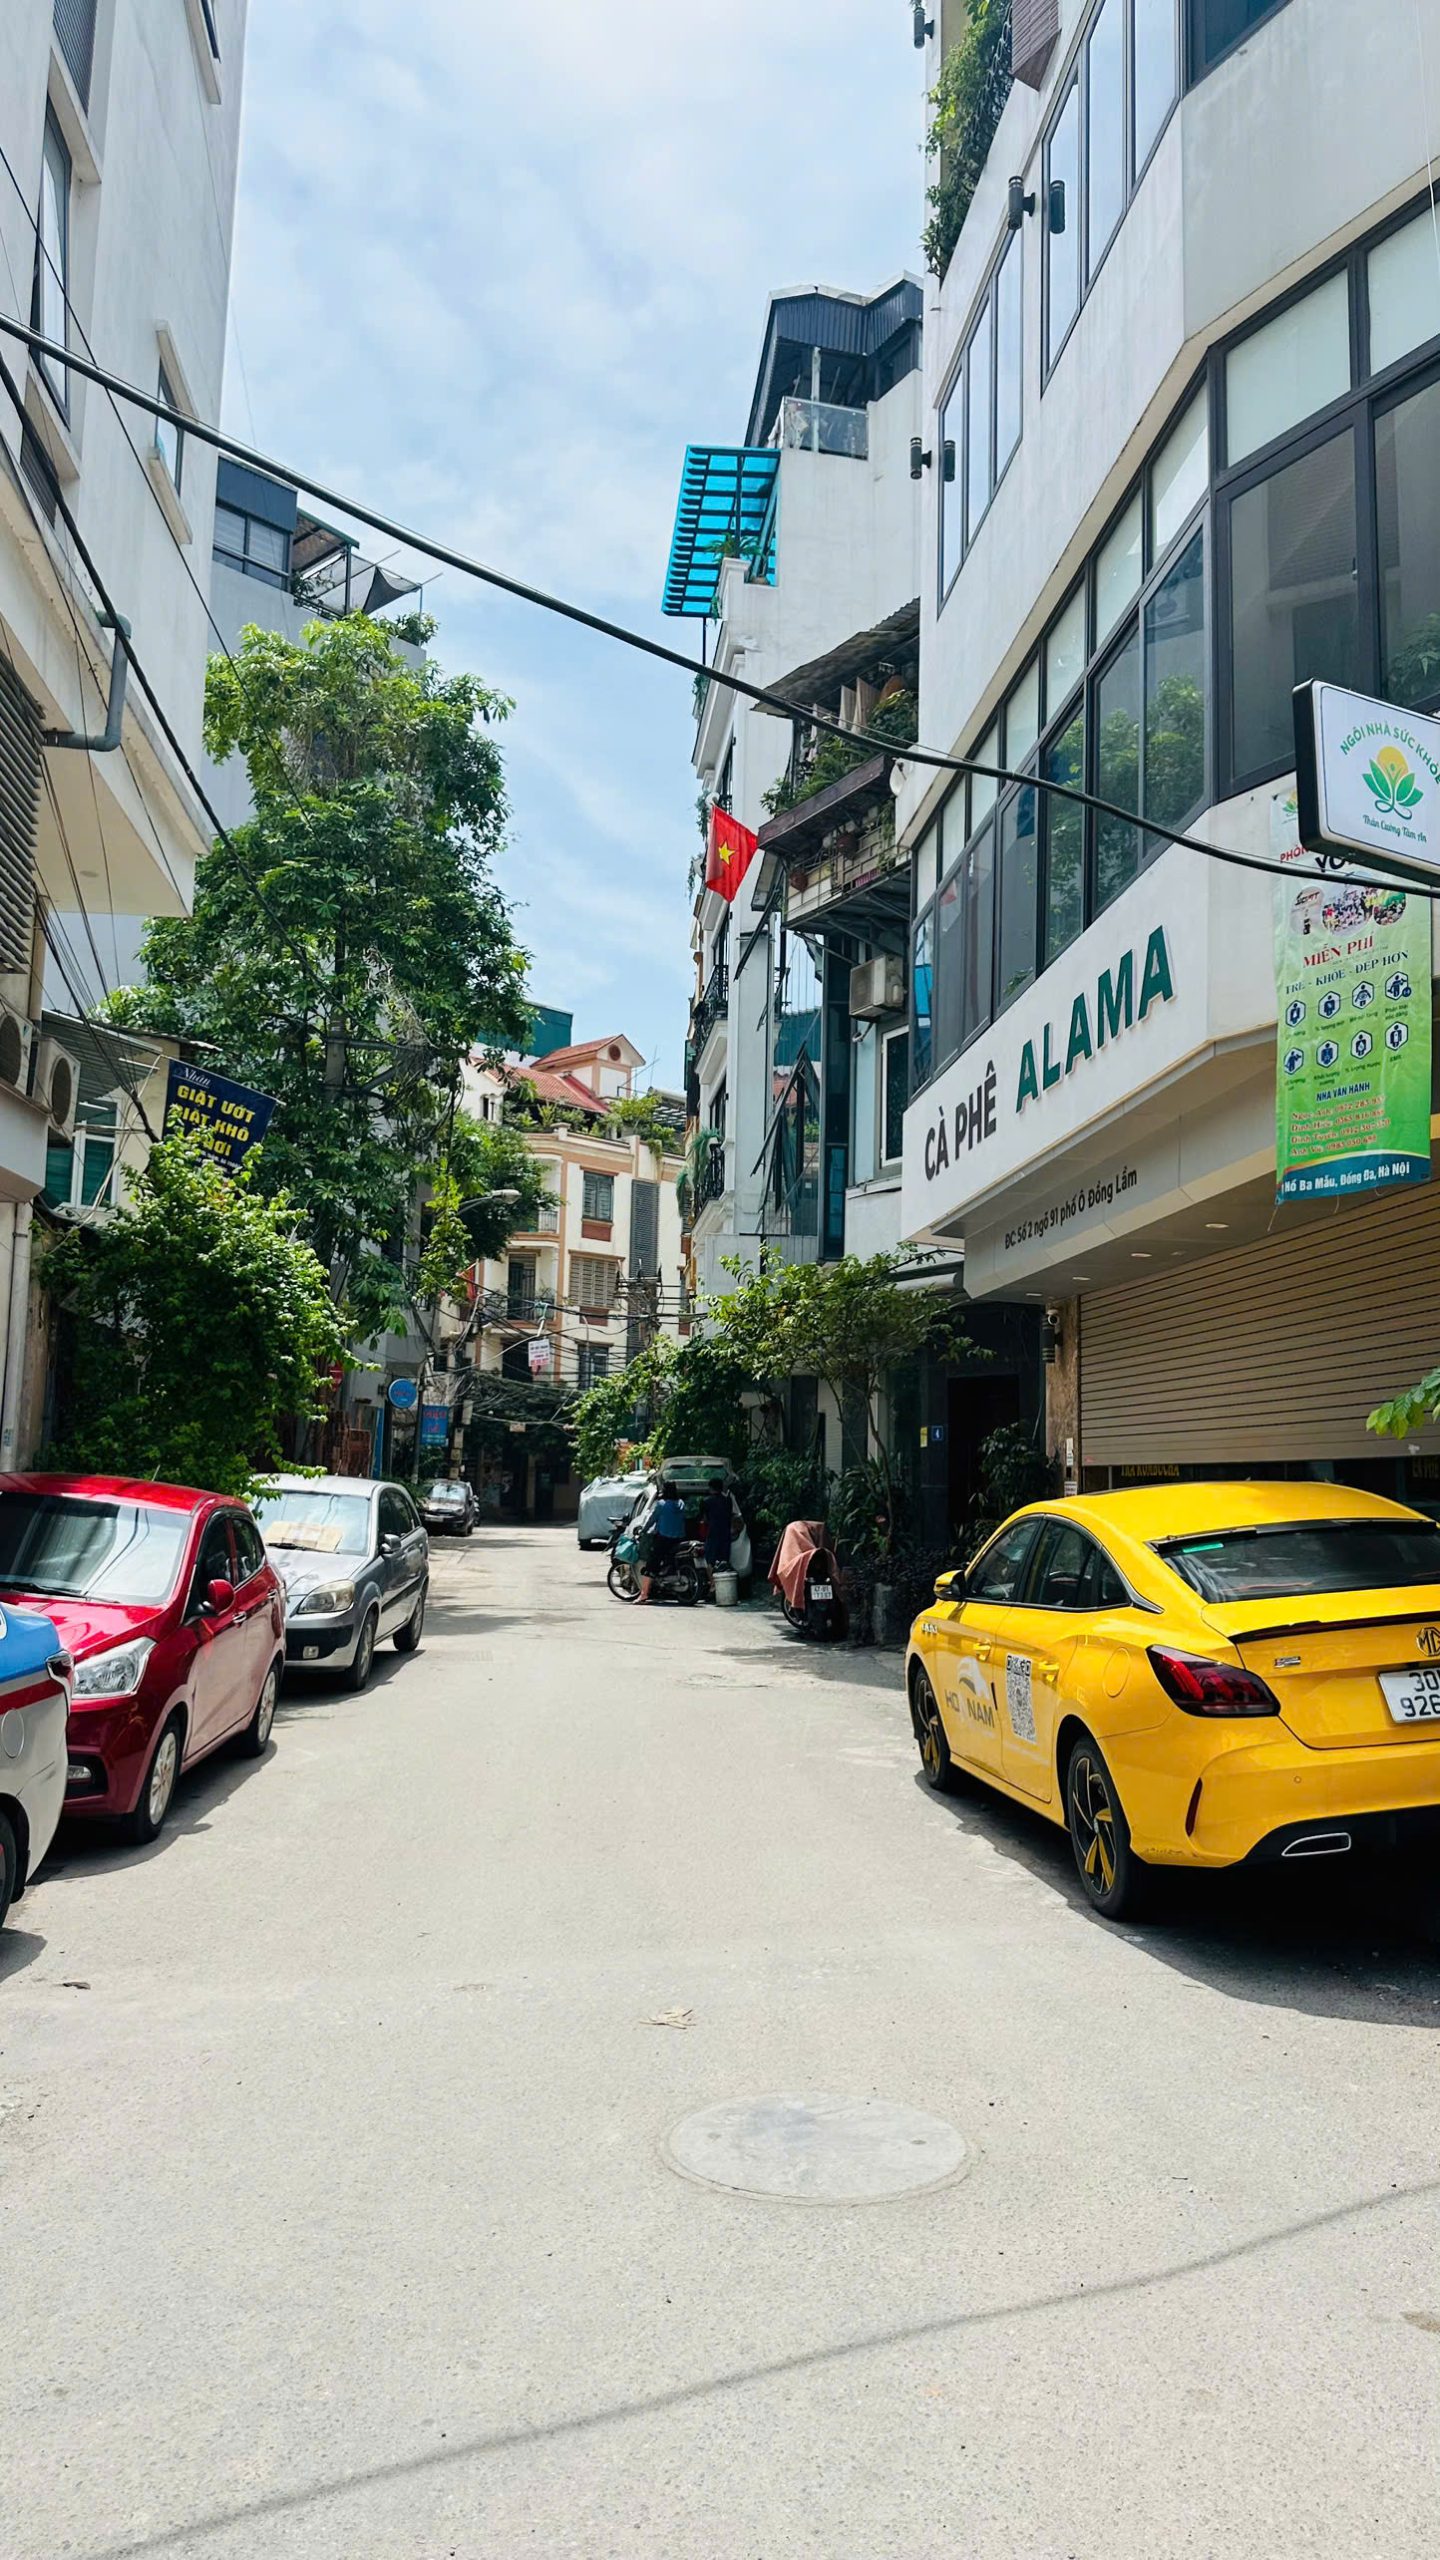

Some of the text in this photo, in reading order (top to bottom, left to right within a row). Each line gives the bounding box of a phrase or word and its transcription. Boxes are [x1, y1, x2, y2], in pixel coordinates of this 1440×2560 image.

[1365, 719, 1391, 736] NHÀ
[1393, 726, 1415, 749] SỨC
[924, 925, 1176, 1181] CÀ PHÊ ALAMA
[221, 1100, 255, 1123] ƯỚT
[1299, 1179, 1313, 1191] Ba
[1378, 1163, 1390, 1178] Hà
[1391, 1161, 1410, 1177] Nội
[1027, 1221, 1033, 1238] 2
[1050, 1206, 1059, 1227] 91
[1060, 1194, 1077, 1226] phố
[1408, 1670, 1440, 1692] 30
